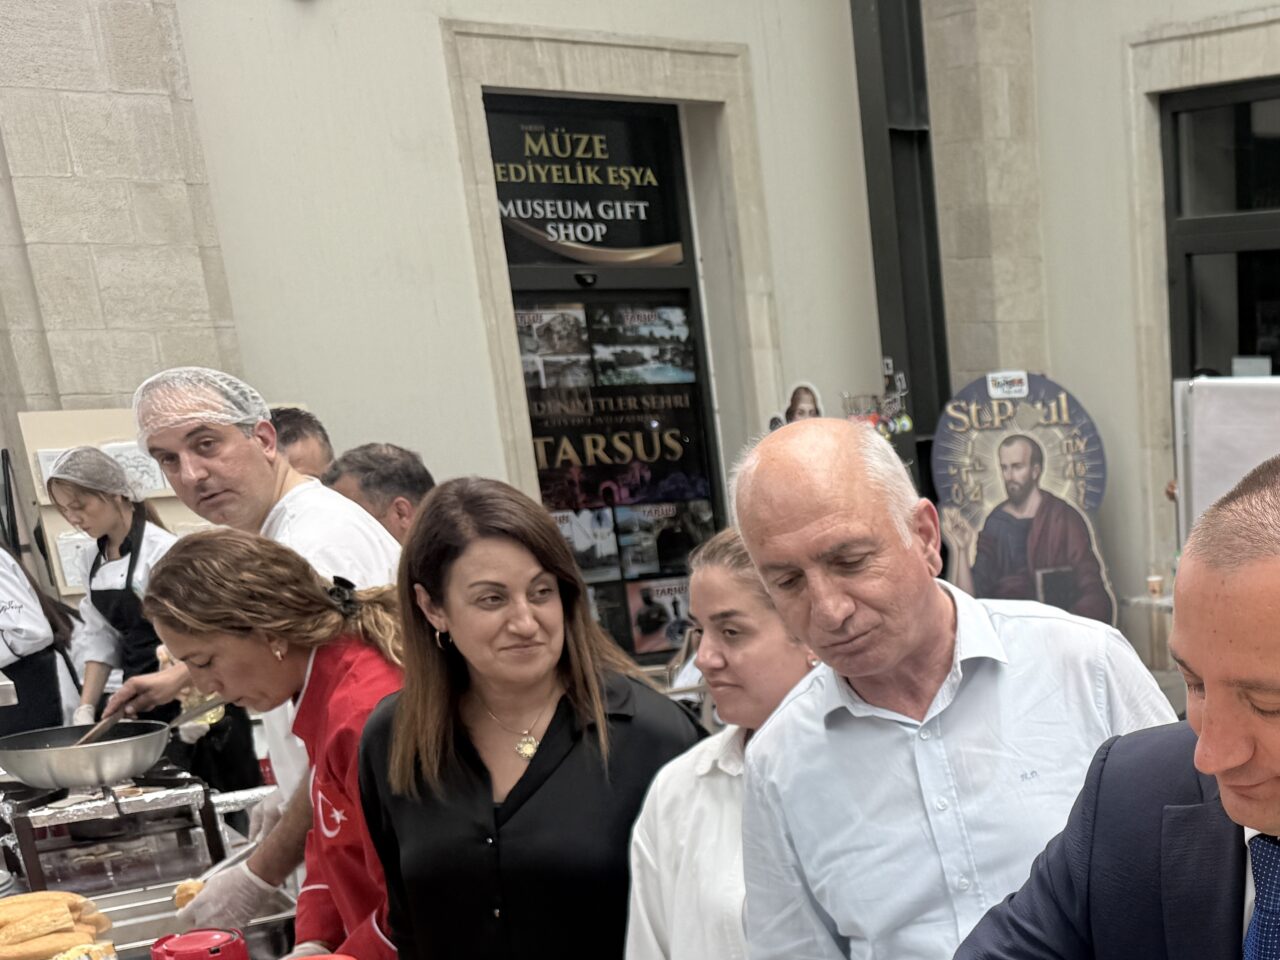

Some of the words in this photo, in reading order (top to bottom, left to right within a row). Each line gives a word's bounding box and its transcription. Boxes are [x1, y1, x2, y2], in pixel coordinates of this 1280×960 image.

[523, 127, 609, 159] MÜZE
[495, 161, 603, 185] EDİYELİK
[607, 165, 659, 190] EŞYA
[499, 199, 594, 220] MUSEUM
[598, 200, 649, 220] GIFT
[546, 222, 608, 242] SHOP
[991, 392, 1072, 429] Pul
[533, 428, 684, 470] TARSUS
